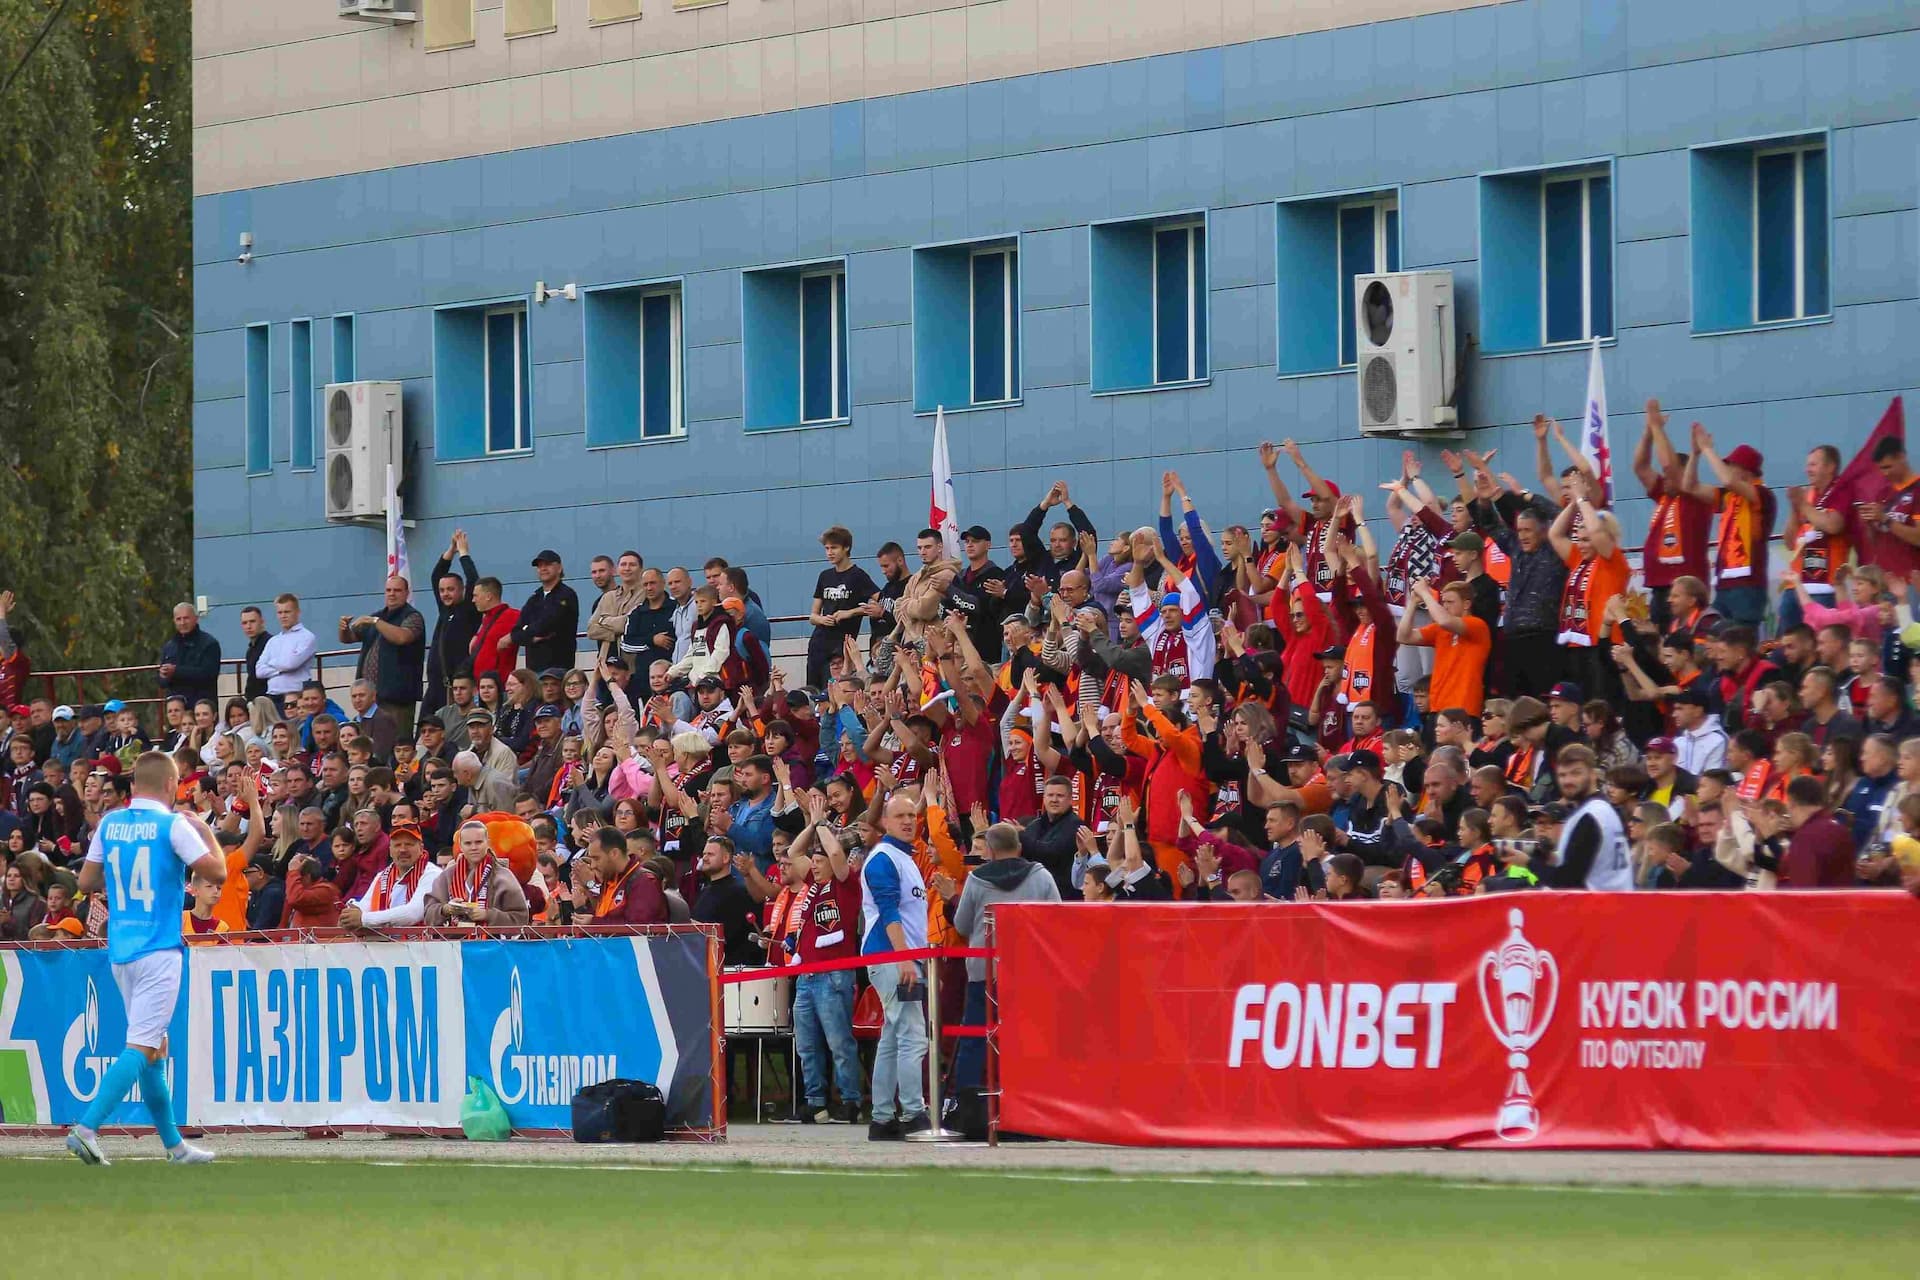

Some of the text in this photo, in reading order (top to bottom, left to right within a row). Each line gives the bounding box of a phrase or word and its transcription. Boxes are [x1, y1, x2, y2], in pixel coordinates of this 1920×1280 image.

[107, 847, 156, 913] 14
[816, 909, 837, 923] ТЕМП
[1227, 982, 1457, 1069] FONBET
[1580, 980, 1838, 1030] КУБОК РОССИИ
[211, 966, 440, 1103] ГАЗПРОМ
[1580, 1039, 1706, 1070] ПО ФУТБОЛУ
